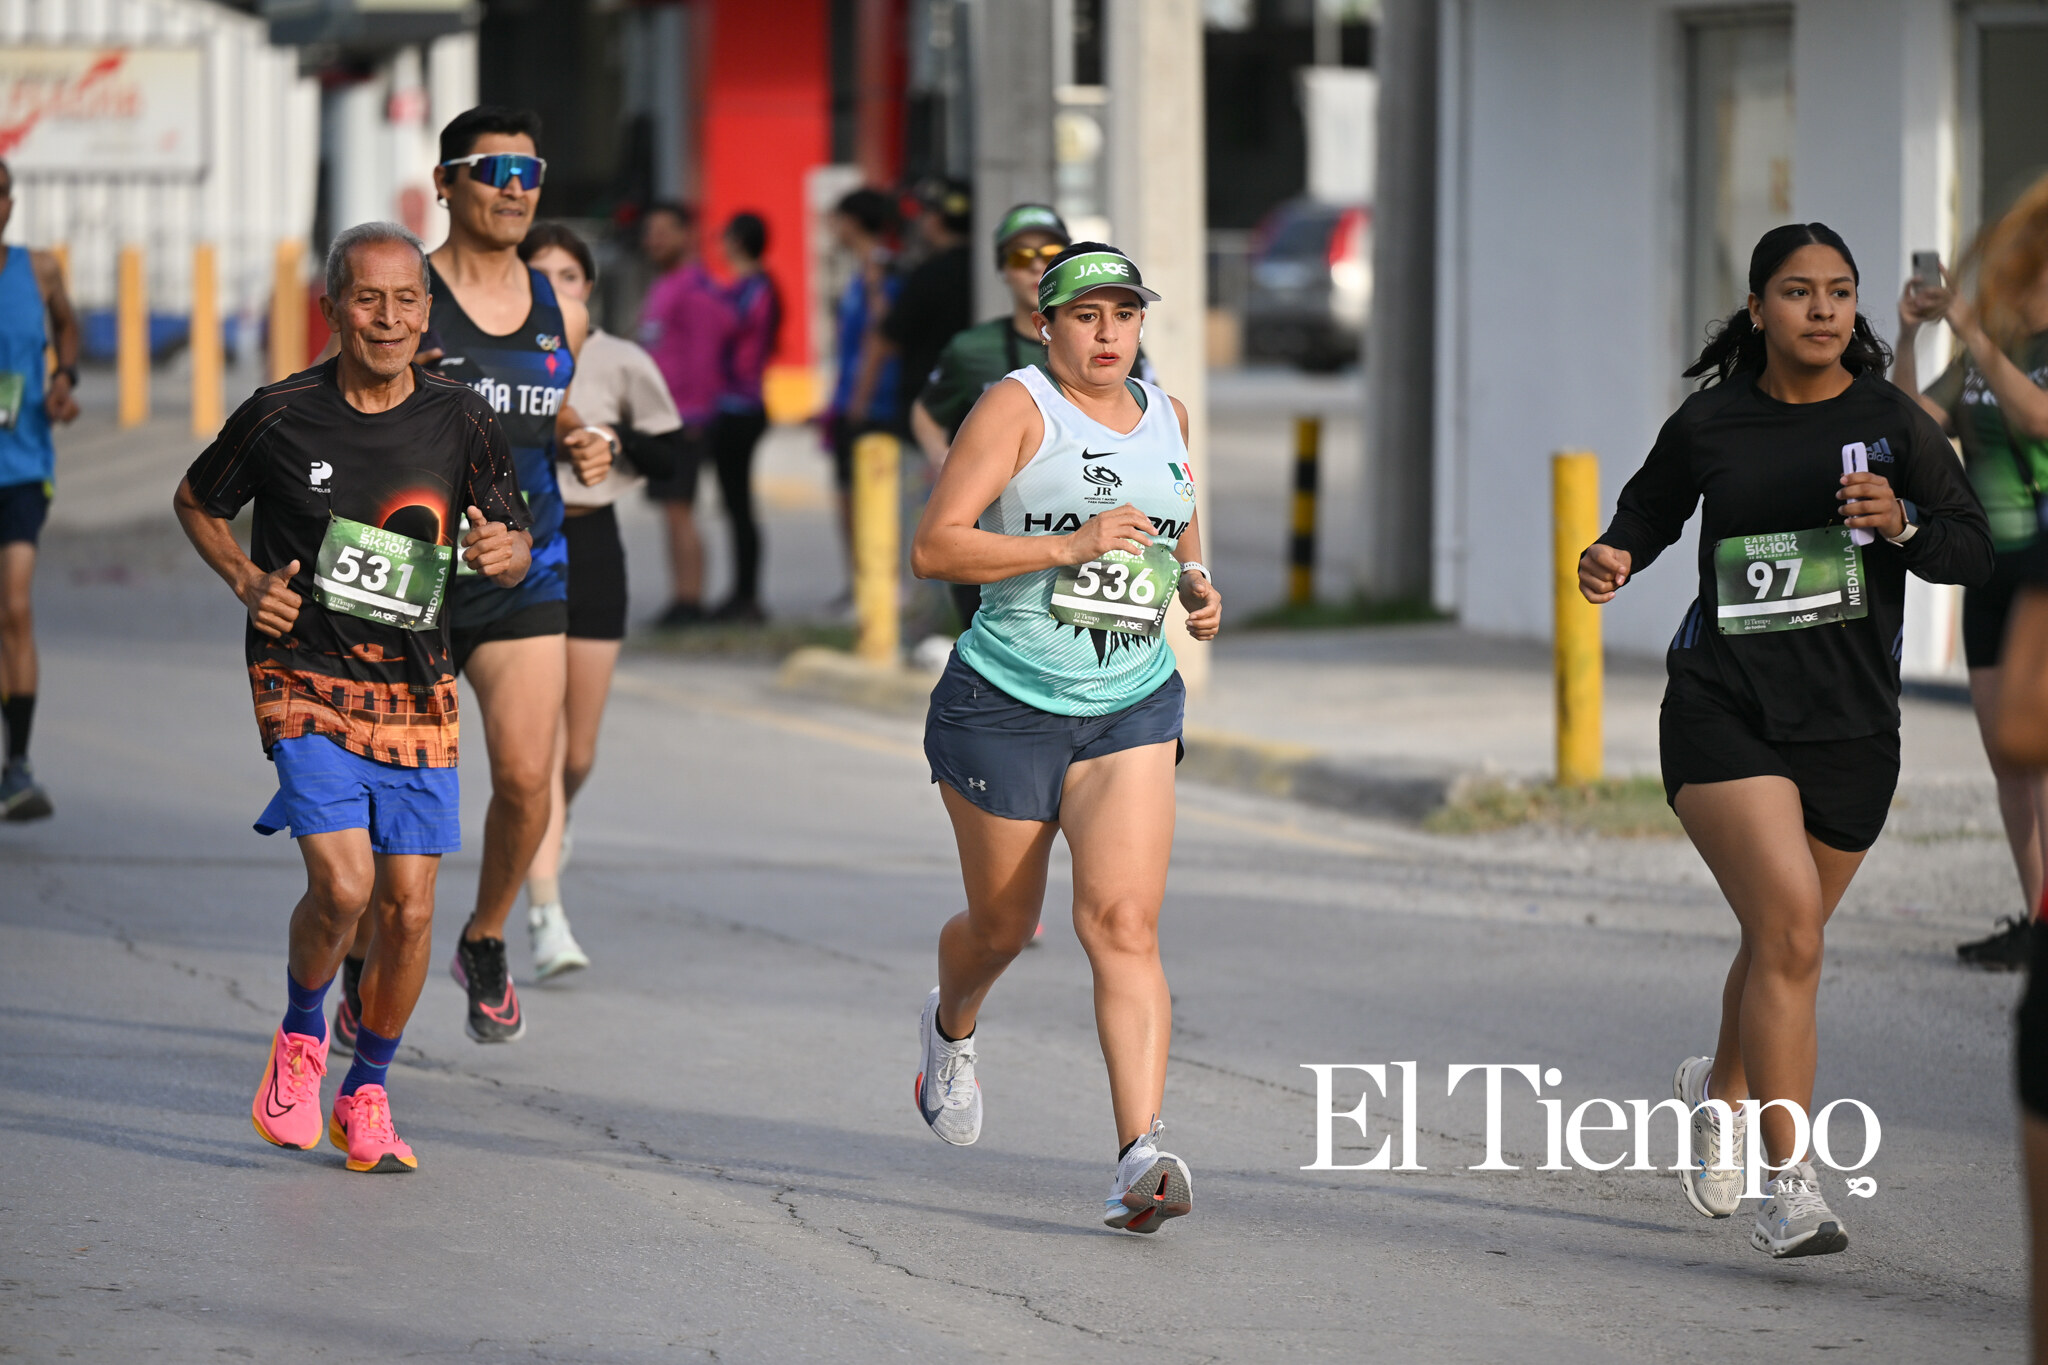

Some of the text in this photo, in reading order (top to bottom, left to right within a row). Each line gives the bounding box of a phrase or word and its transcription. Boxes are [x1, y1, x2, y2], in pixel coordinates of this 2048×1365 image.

[1866, 450, 1895, 464] didas
[1094, 487, 1112, 496] JR
[362, 526, 413, 548] CARRERA
[438, 552, 450, 561] 531
[1744, 534, 1797, 545] CARRERA
[331, 545, 415, 599] 531
[1072, 561, 1156, 605] 536
[1747, 557, 1804, 600] 97
[1843, 544, 1862, 606] MEDALLA
[422, 567, 447, 624] MEDALLA
[1153, 568, 1179, 627] MEDALLA
